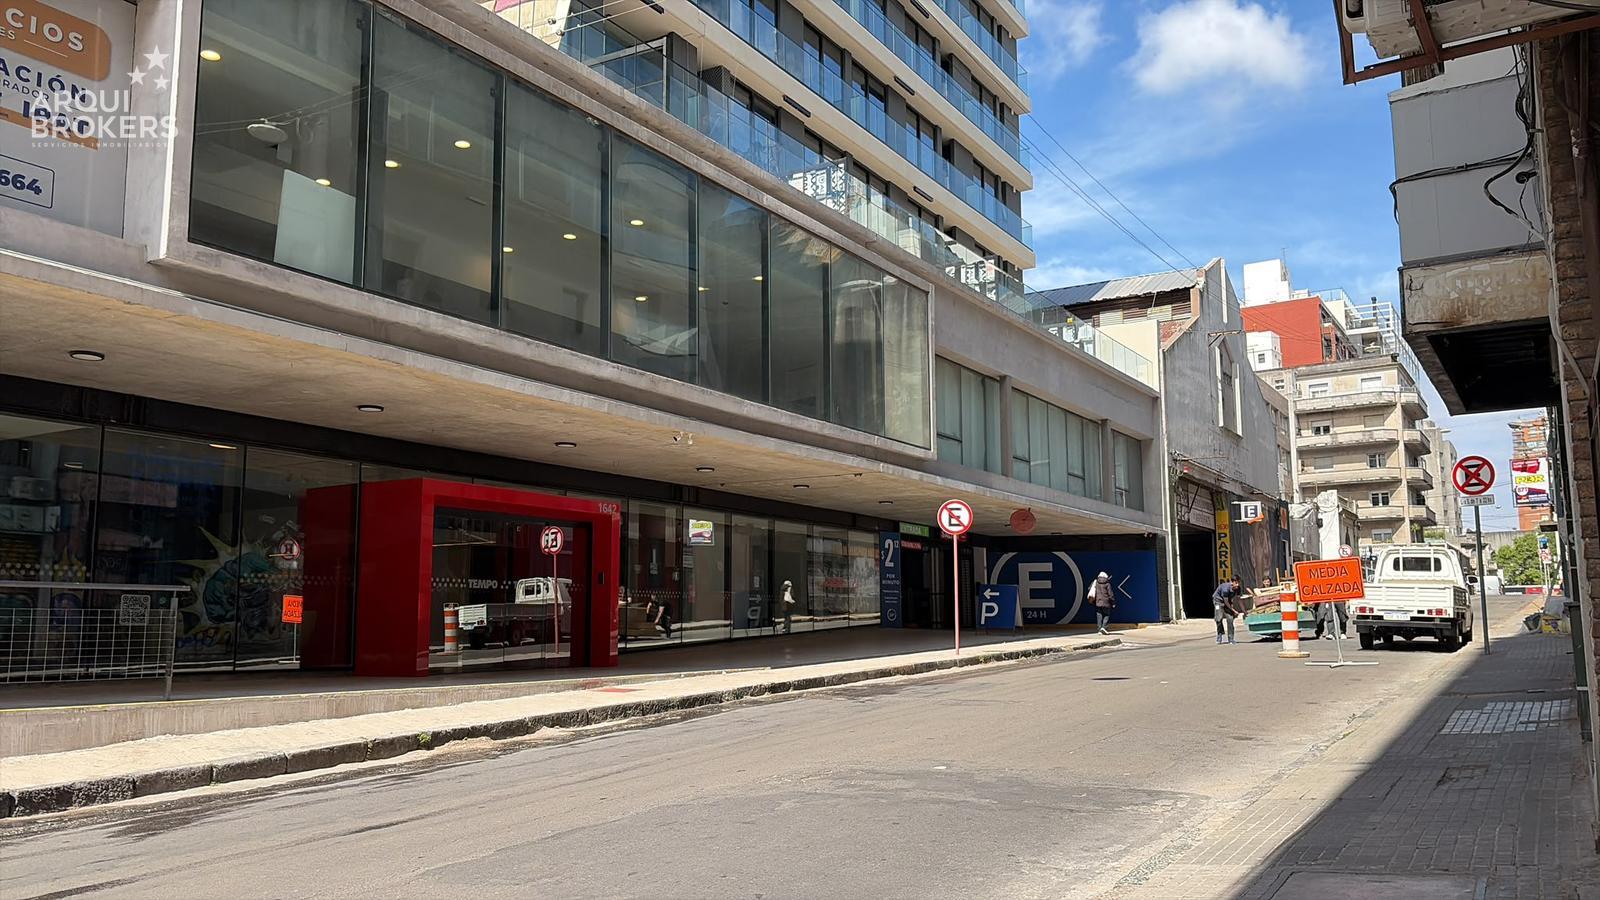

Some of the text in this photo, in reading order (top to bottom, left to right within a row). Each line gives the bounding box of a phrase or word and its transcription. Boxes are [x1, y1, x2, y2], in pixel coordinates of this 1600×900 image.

[5, 8, 84, 52] CIOS
[599, 503, 617, 513] 1642
[1247, 506, 1256, 518] E
[1308, 565, 1349, 579] MEDIA
[468, 579, 498, 589] TEMPO
[1018, 562, 1055, 608] E
[1302, 581, 1361, 596] CALZADA
[980, 602, 999, 625] P
[1027, 611, 1047, 619] 24 H
